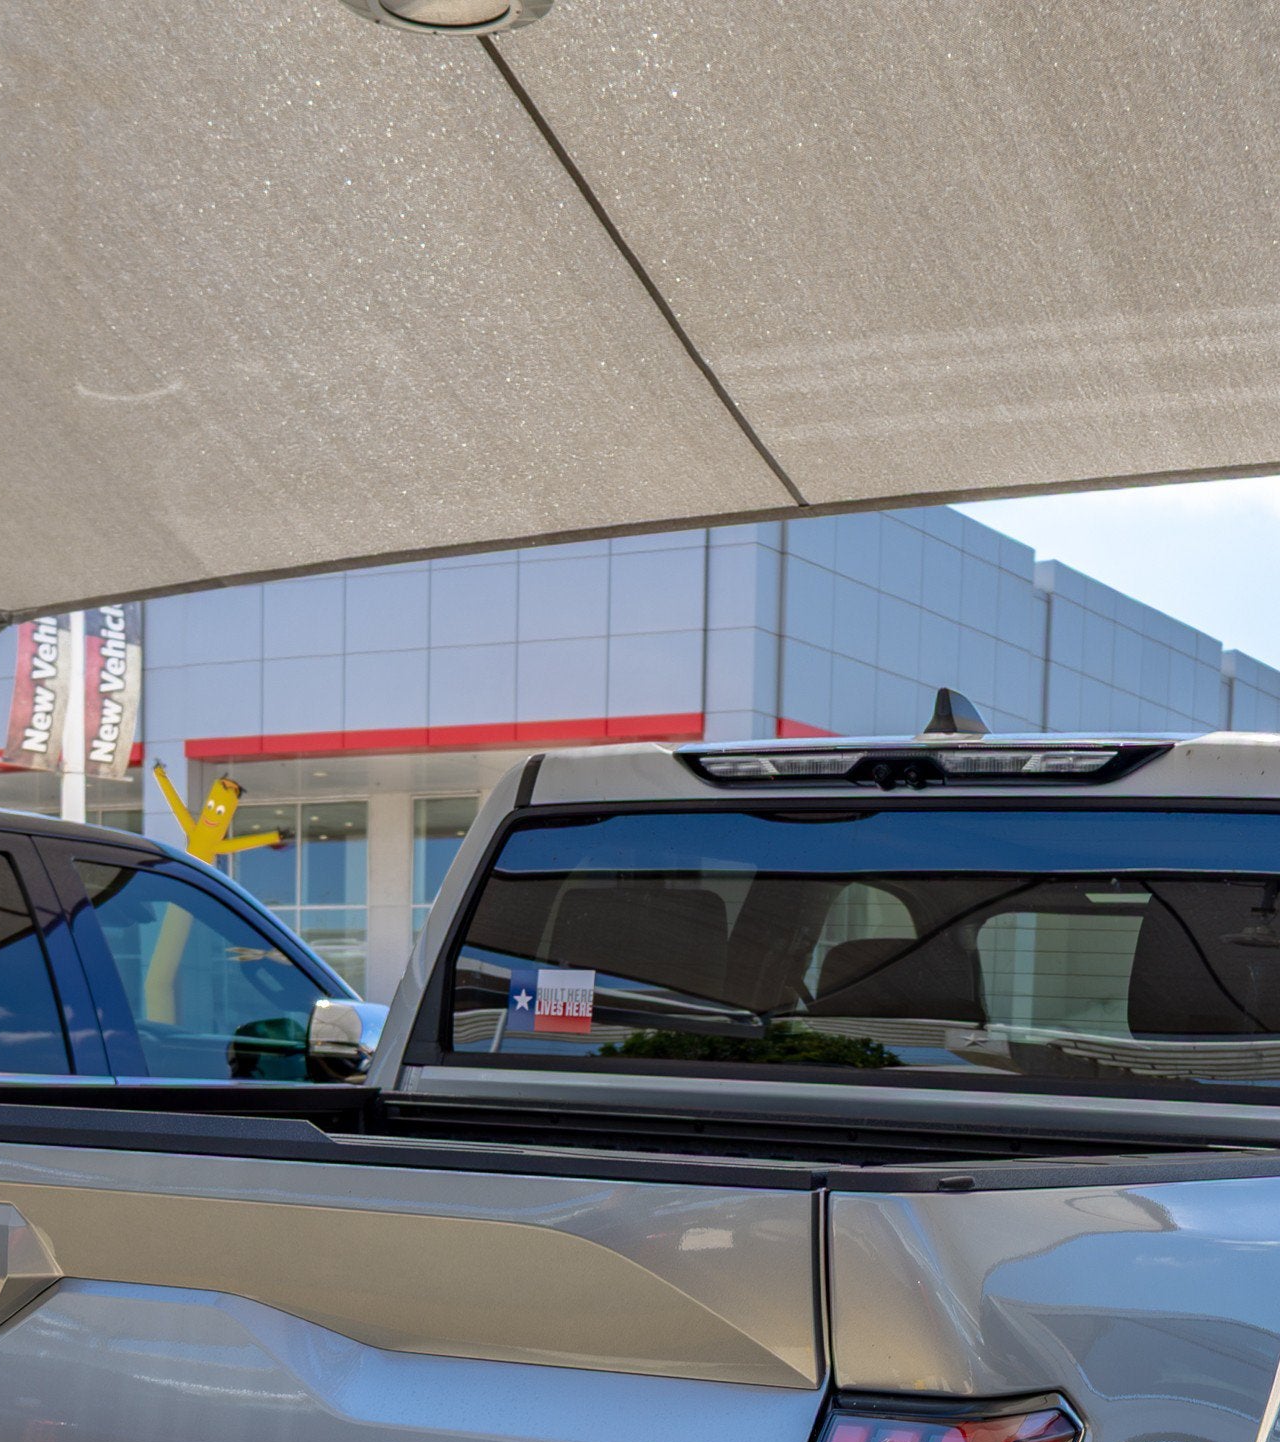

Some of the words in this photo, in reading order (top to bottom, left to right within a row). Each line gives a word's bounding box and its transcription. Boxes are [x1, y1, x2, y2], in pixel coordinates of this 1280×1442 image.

[100, 604, 126, 693] Vehicl
[22, 686, 55, 753] New
[89, 699, 123, 762] New
[535, 1000, 564, 1016] LIVES
[565, 1001, 593, 1017] HERE
[537, 988, 565, 1002] BUILT
[567, 989, 594, 1003] HERE
